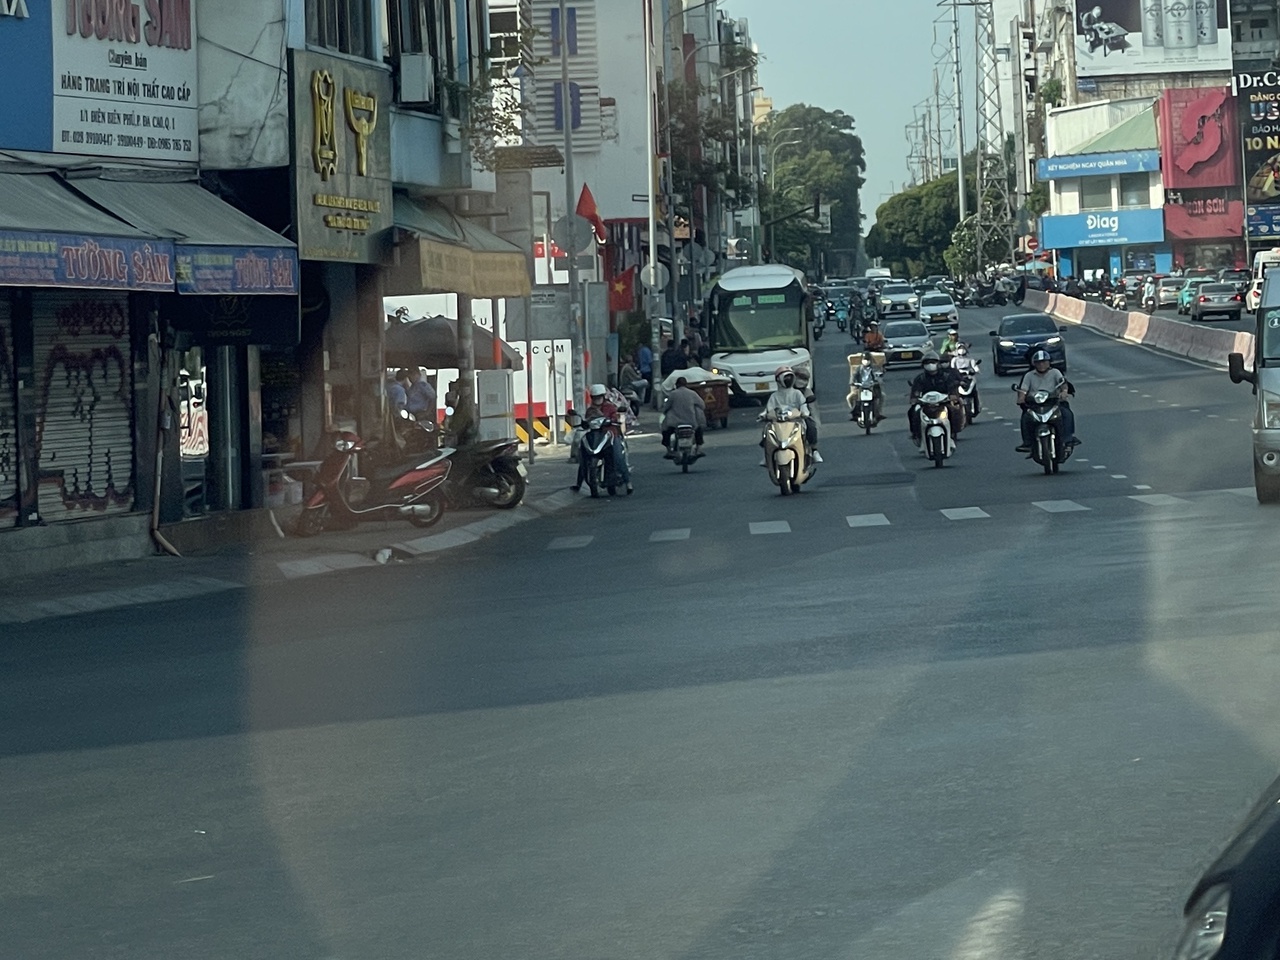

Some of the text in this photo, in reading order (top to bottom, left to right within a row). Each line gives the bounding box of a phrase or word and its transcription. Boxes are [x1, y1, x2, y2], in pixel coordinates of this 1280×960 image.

[84, 77, 110, 93] TRANG
[112, 77, 125, 95] TRÍ
[1245, 137, 1263, 150] 10
